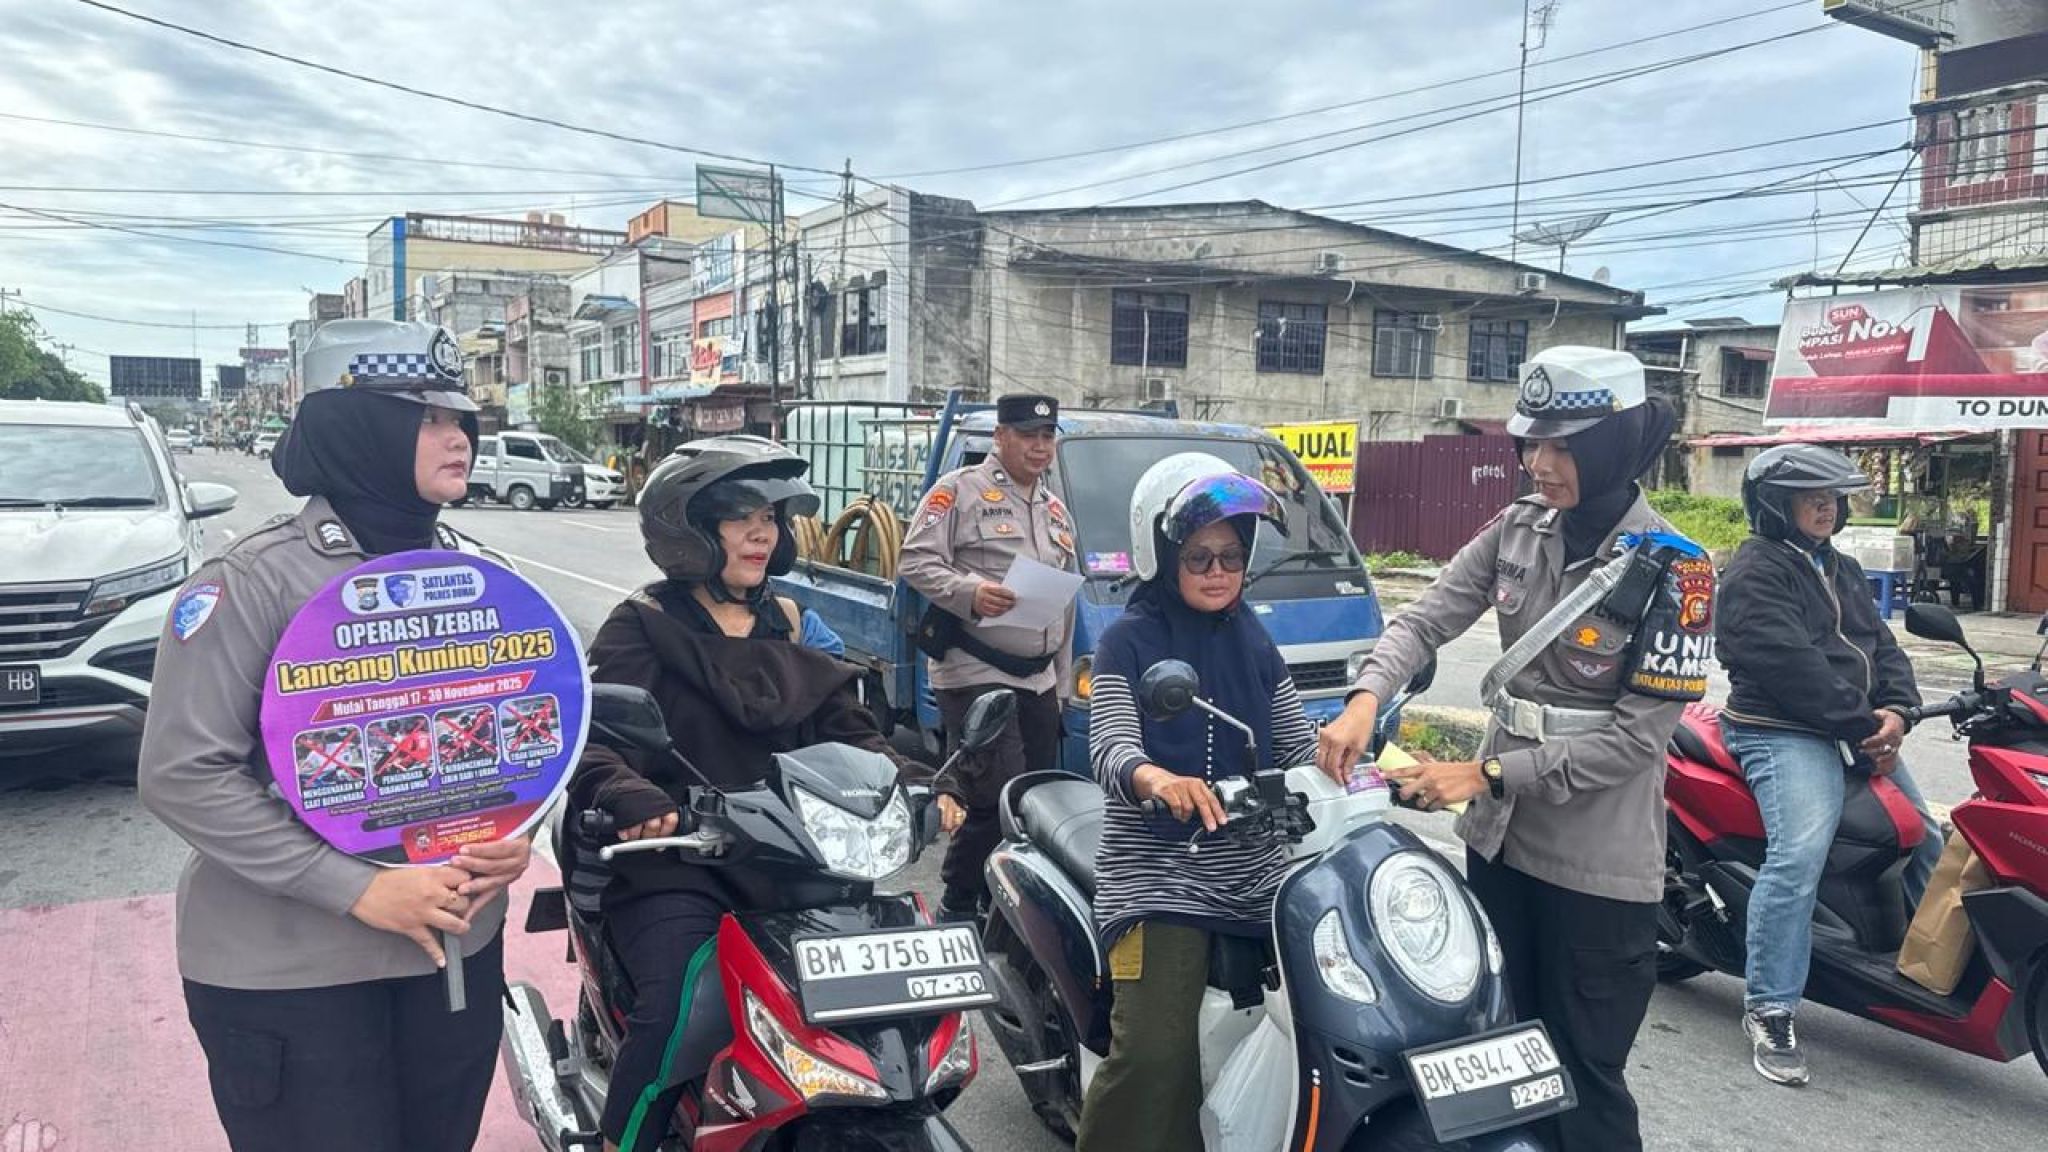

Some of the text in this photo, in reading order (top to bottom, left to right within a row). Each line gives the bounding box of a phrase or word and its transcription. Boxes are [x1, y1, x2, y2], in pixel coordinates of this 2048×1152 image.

[1831, 307, 1859, 320] SUN
[1799, 334, 1844, 348] MPASI
[1957, 400, 1991, 417] TO
[1293, 431, 1353, 459] JUAL
[421, 572, 474, 590] SATLANTAS
[336, 608, 500, 649] OPERASI ZEBRA
[1654, 631, 1716, 658] UNIT
[278, 630, 553, 693] Lancang Kuning 2025
[7, 671, 36, 691] HB
[333, 700, 364, 716] Mulai
[366, 692, 408, 712] Tanggal
[410, 691, 420, 704] 17
[428, 688, 443, 702] 30
[444, 681, 495, 699] November
[496, 677, 523, 692] 2025
[805, 934, 978, 976] BM 3756 HN
[1454, 1047, 1513, 1084] 6944
[1514, 1036, 1553, 1071] HR
